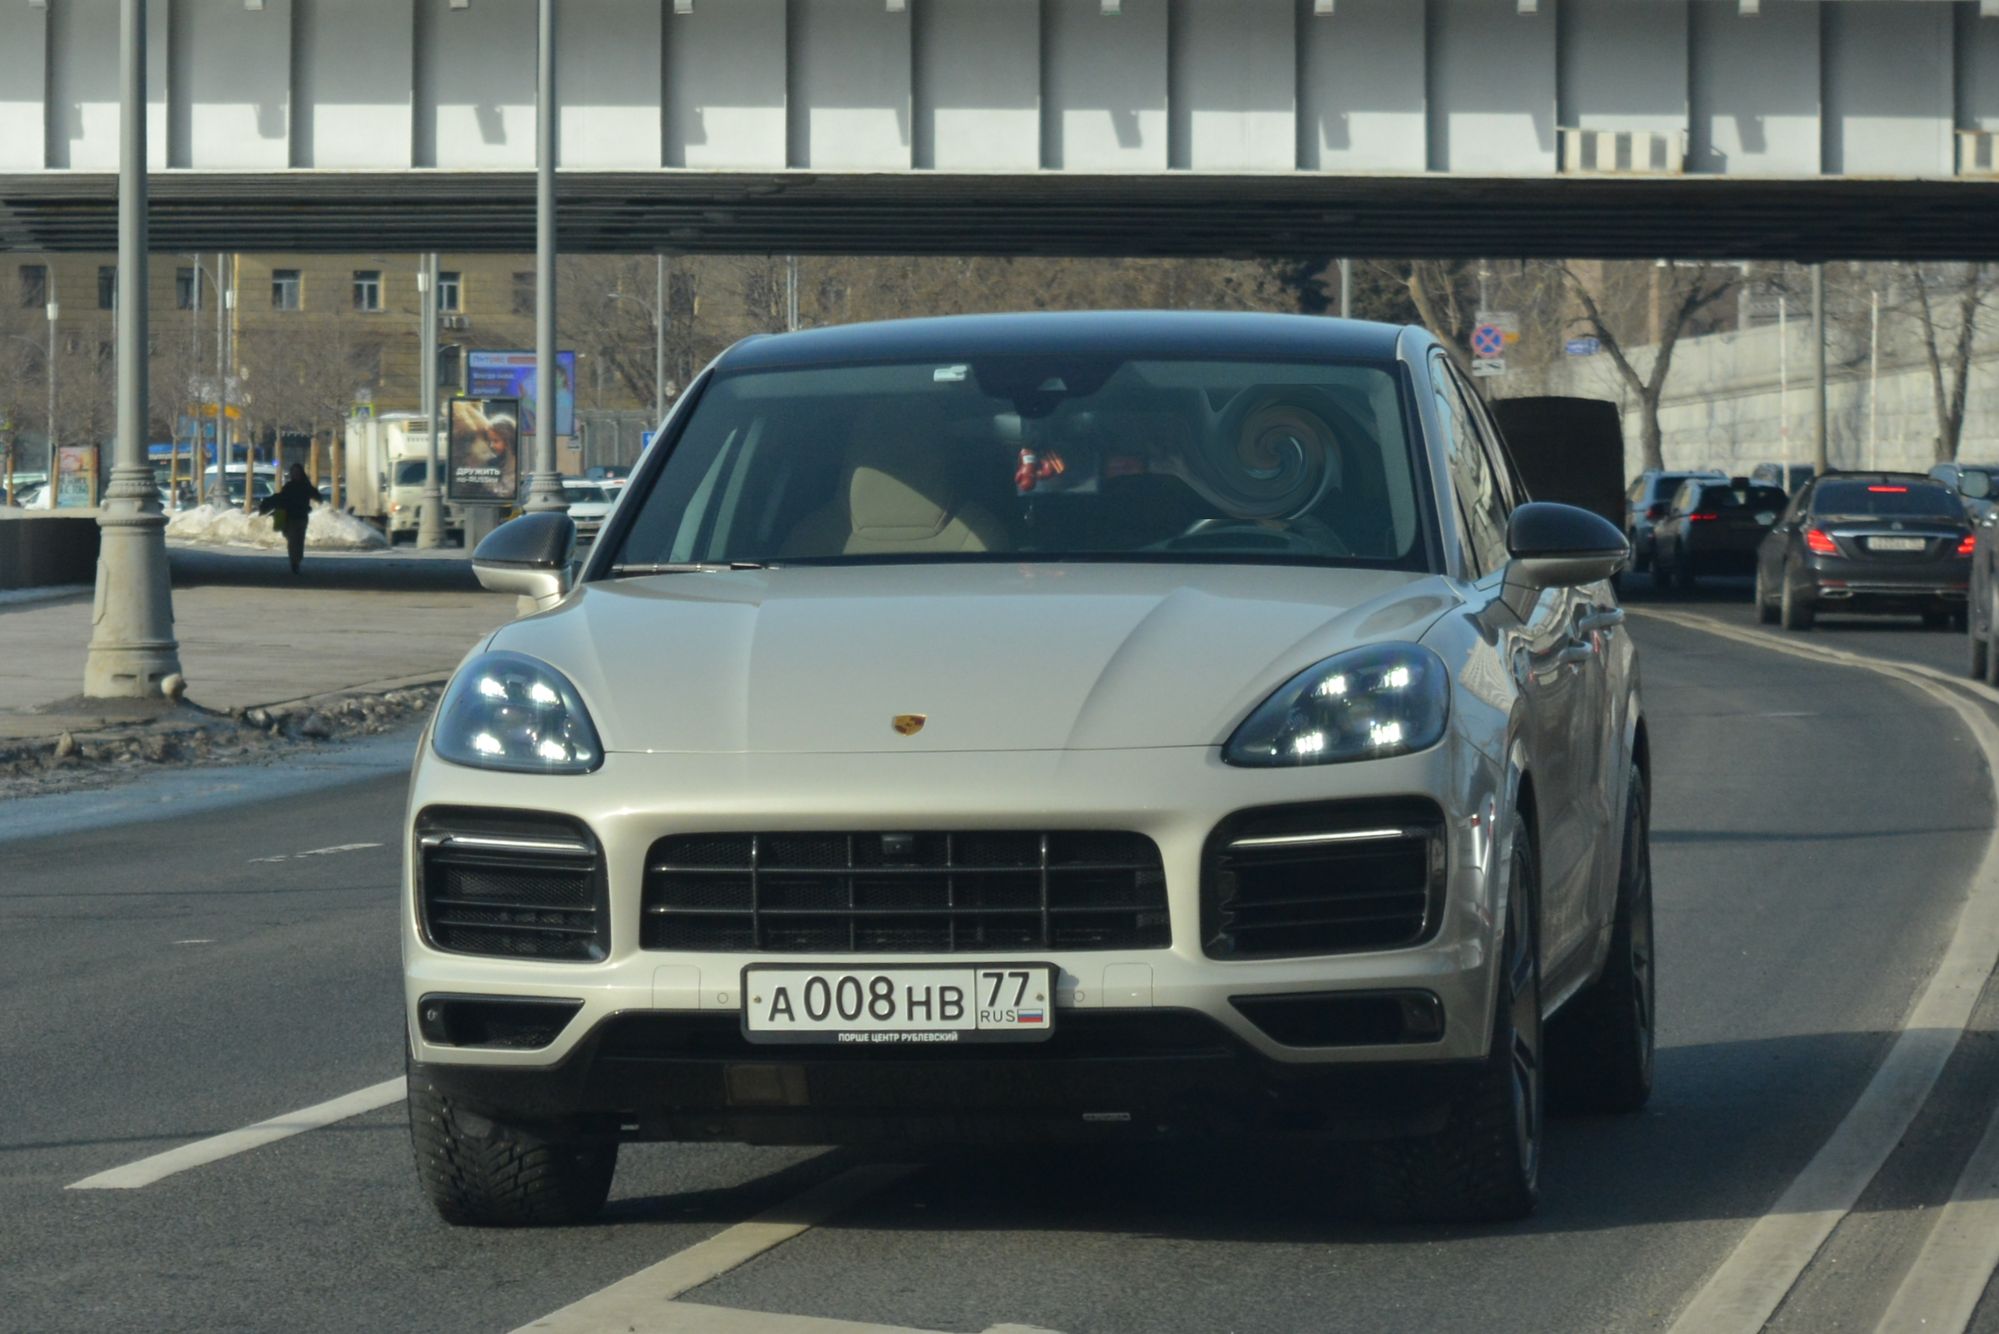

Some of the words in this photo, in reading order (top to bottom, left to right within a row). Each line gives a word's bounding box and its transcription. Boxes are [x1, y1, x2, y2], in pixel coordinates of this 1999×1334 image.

[982, 971, 1031, 1007] 77
[980, 1010, 1016, 1022] RUS
[838, 1033, 869, 1042] ПОРШЕ
[871, 1033, 900, 1043] ЦЕНТР
[901, 1031, 958, 1042] РУБЛЕВСКИЙ
